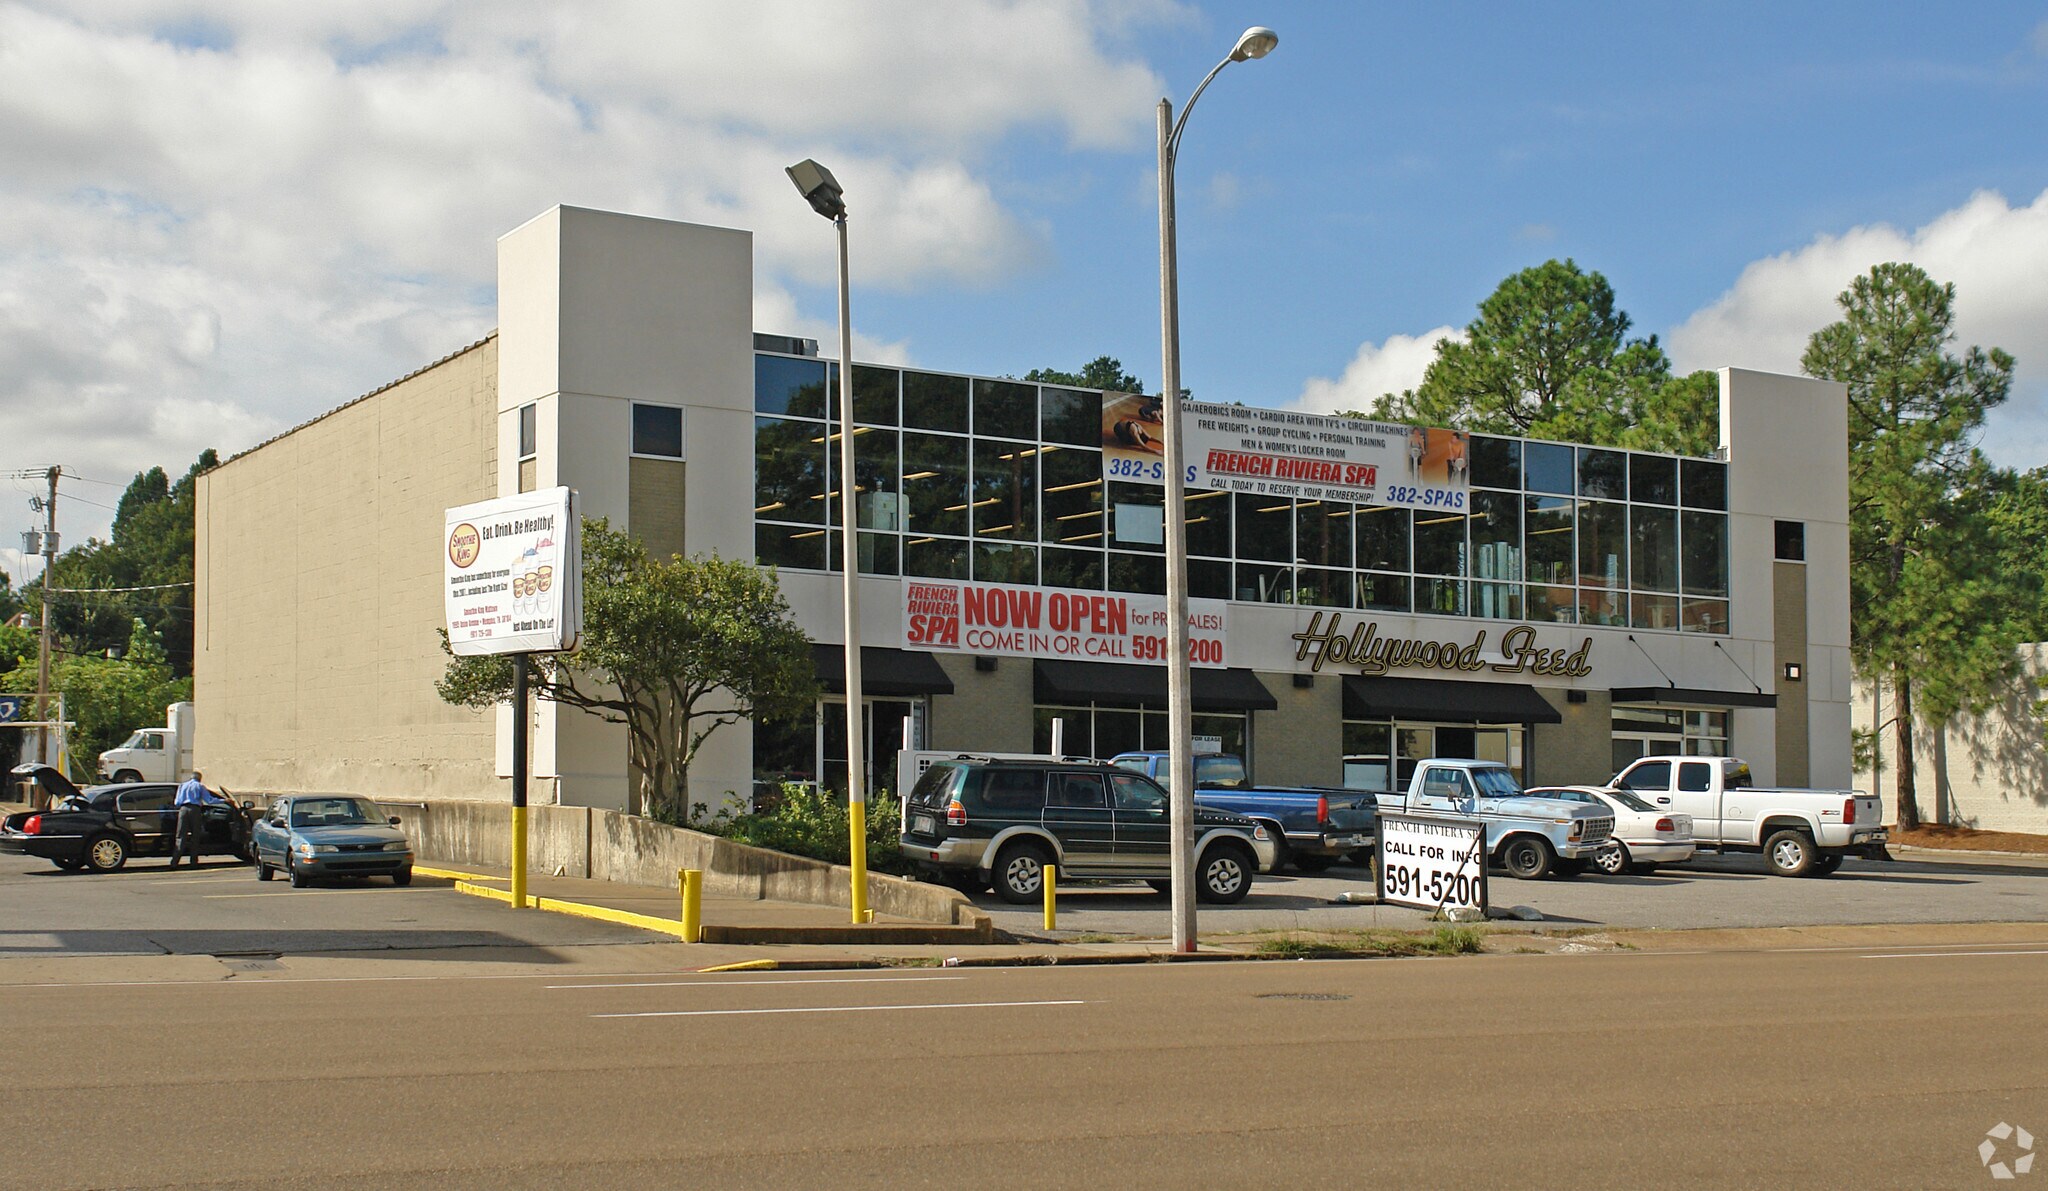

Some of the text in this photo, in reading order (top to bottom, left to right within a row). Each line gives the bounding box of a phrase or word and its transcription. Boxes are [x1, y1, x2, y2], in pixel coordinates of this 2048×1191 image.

[1182, 403, 1408, 436] GA/AEROBICS ROOM CARDIO AREA WITH TV'S CIRCUIT MACHINES
[1198, 419, 1386, 448] FREE WEIGHTS GROUP CYCLING PERSONAL TRAINING
[1241, 439, 1346, 458] MEN & WOMEN'S LOCKER ROOM
[1109, 458, 1197, 482] 382-SS
[1206, 451, 1376, 485] FRENCH RIVIERA SPA
[1211, 477, 1374, 502] CALL TODAY TO RESERVE YOUR MEMBERSHIP!
[1386, 485, 1464, 508] 382-SPAS
[483, 515, 554, 540] Eat. Drink. Be Healthy!
[907, 586, 958, 601] FRENCH
[907, 600, 959, 616] RIVIERA
[963, 586, 1042, 629] NOW
[1049, 593, 1127, 635] OPEN
[1132, 608, 1149, 626] for
[907, 615, 960, 643] SPA
[966, 629, 1223, 663] COME IN OR CALL 591200
[1292, 611, 1593, 677] Hollywood Feed
[1384, 820, 1420, 833] FRENCH
[1424, 824, 1463, 839] RIVIERA
[1385, 841, 1415, 856] CALL
[1420, 845, 1444, 860] FOR
[1386, 863, 1482, 908] 591-5200
